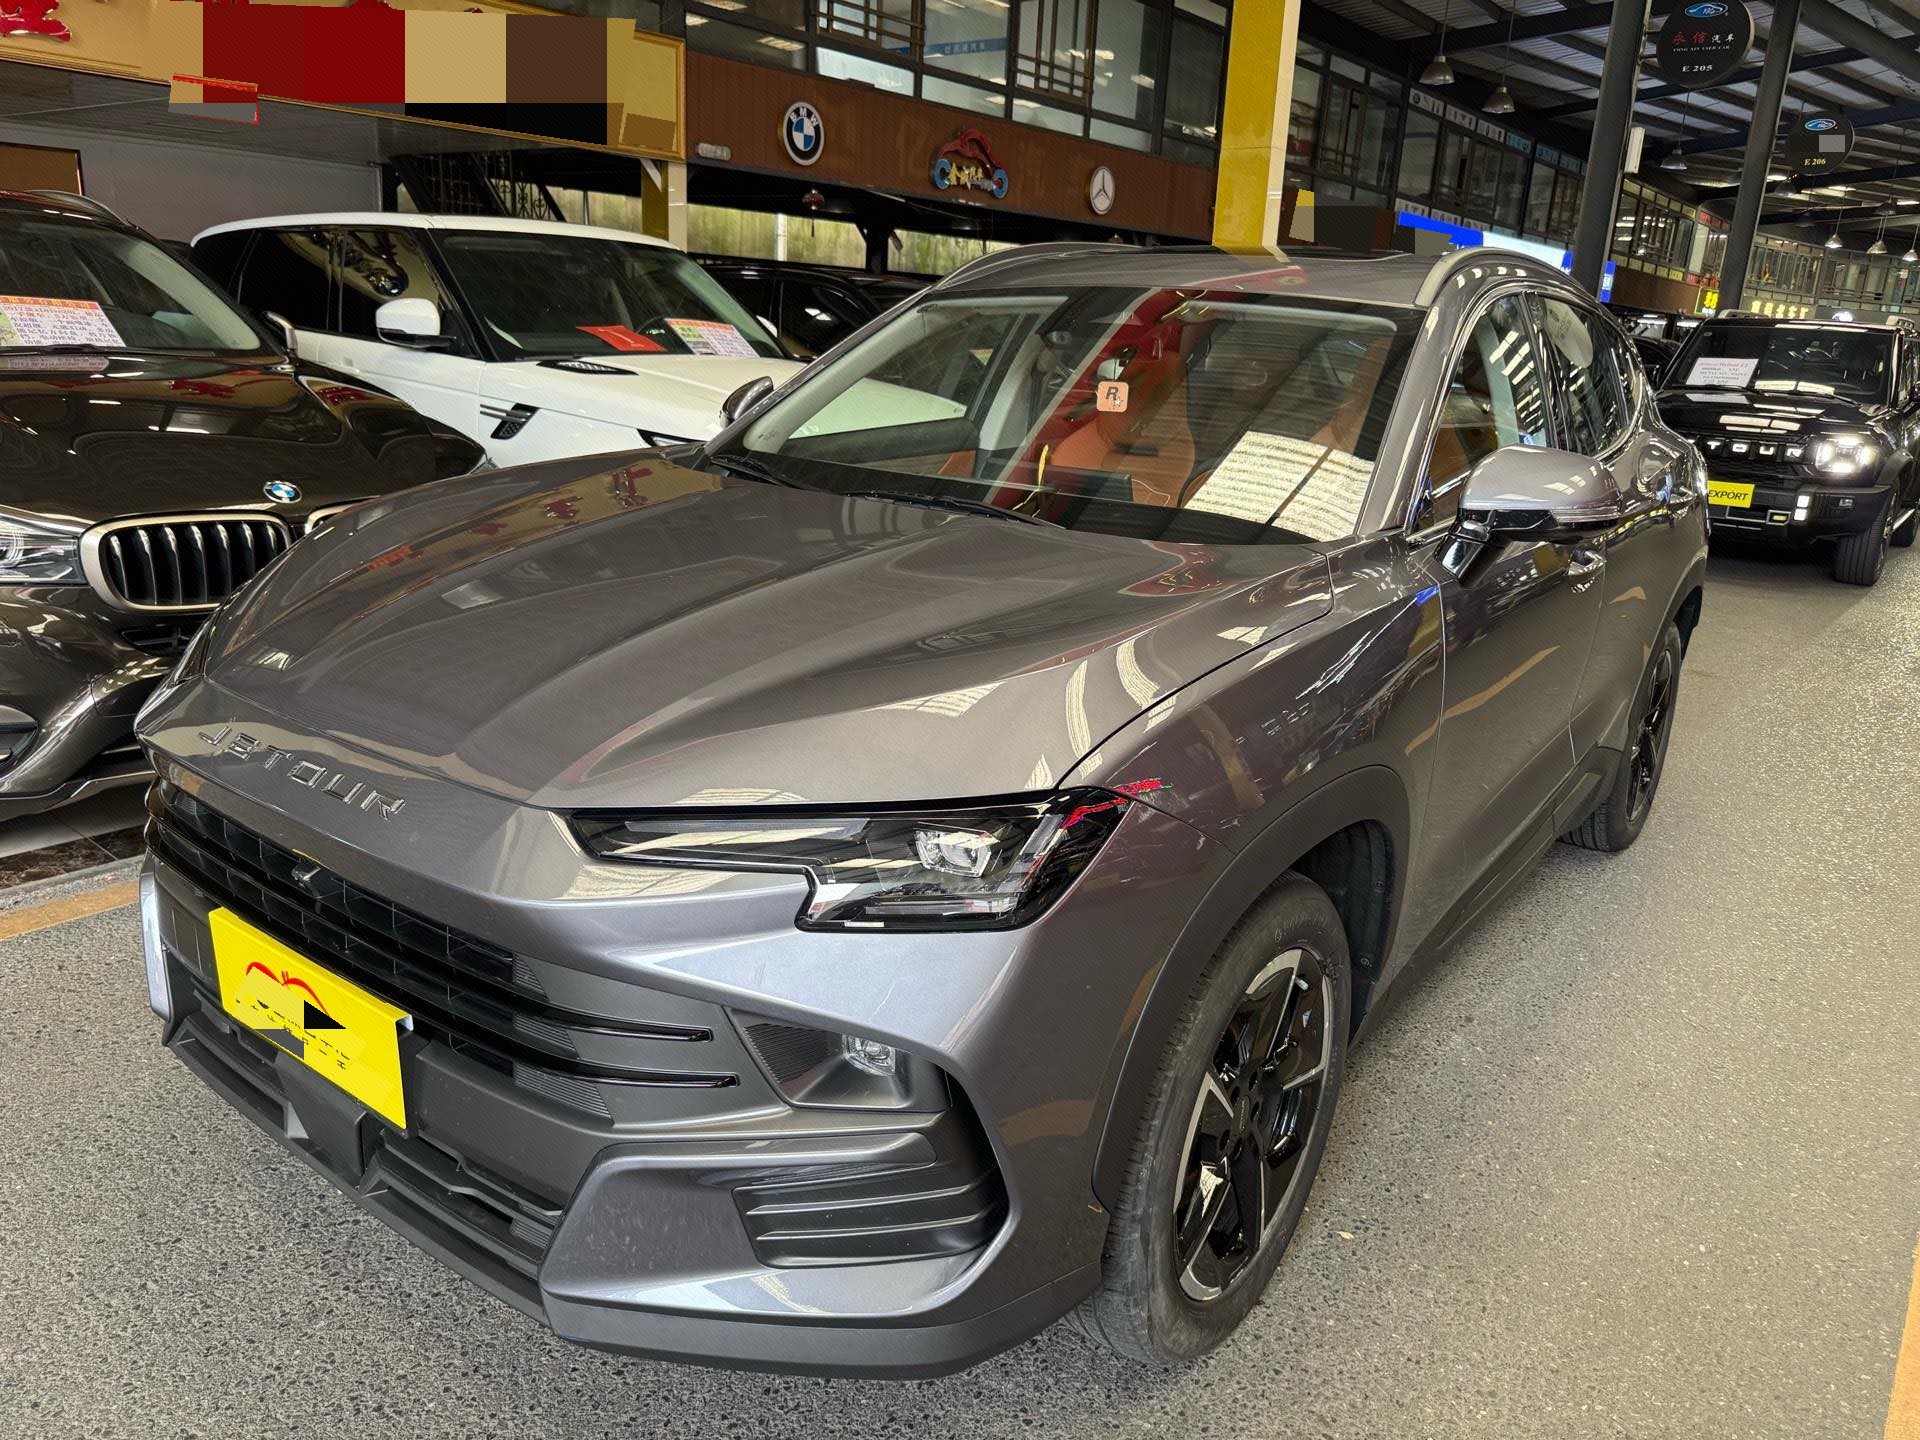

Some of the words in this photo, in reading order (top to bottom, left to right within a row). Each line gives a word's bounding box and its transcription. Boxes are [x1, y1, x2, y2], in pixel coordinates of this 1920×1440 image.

[1692, 64, 1713, 72] 205
[789, 106, 820, 128] BMW
[1804, 158, 1811, 166] E
[1811, 158, 1827, 166] 206
[1105, 386, 1119, 401] R
[1687, 438, 1803, 458] TOUR
[1708, 489, 1749, 501] EXPORT
[198, 725, 406, 822] JETOUR
